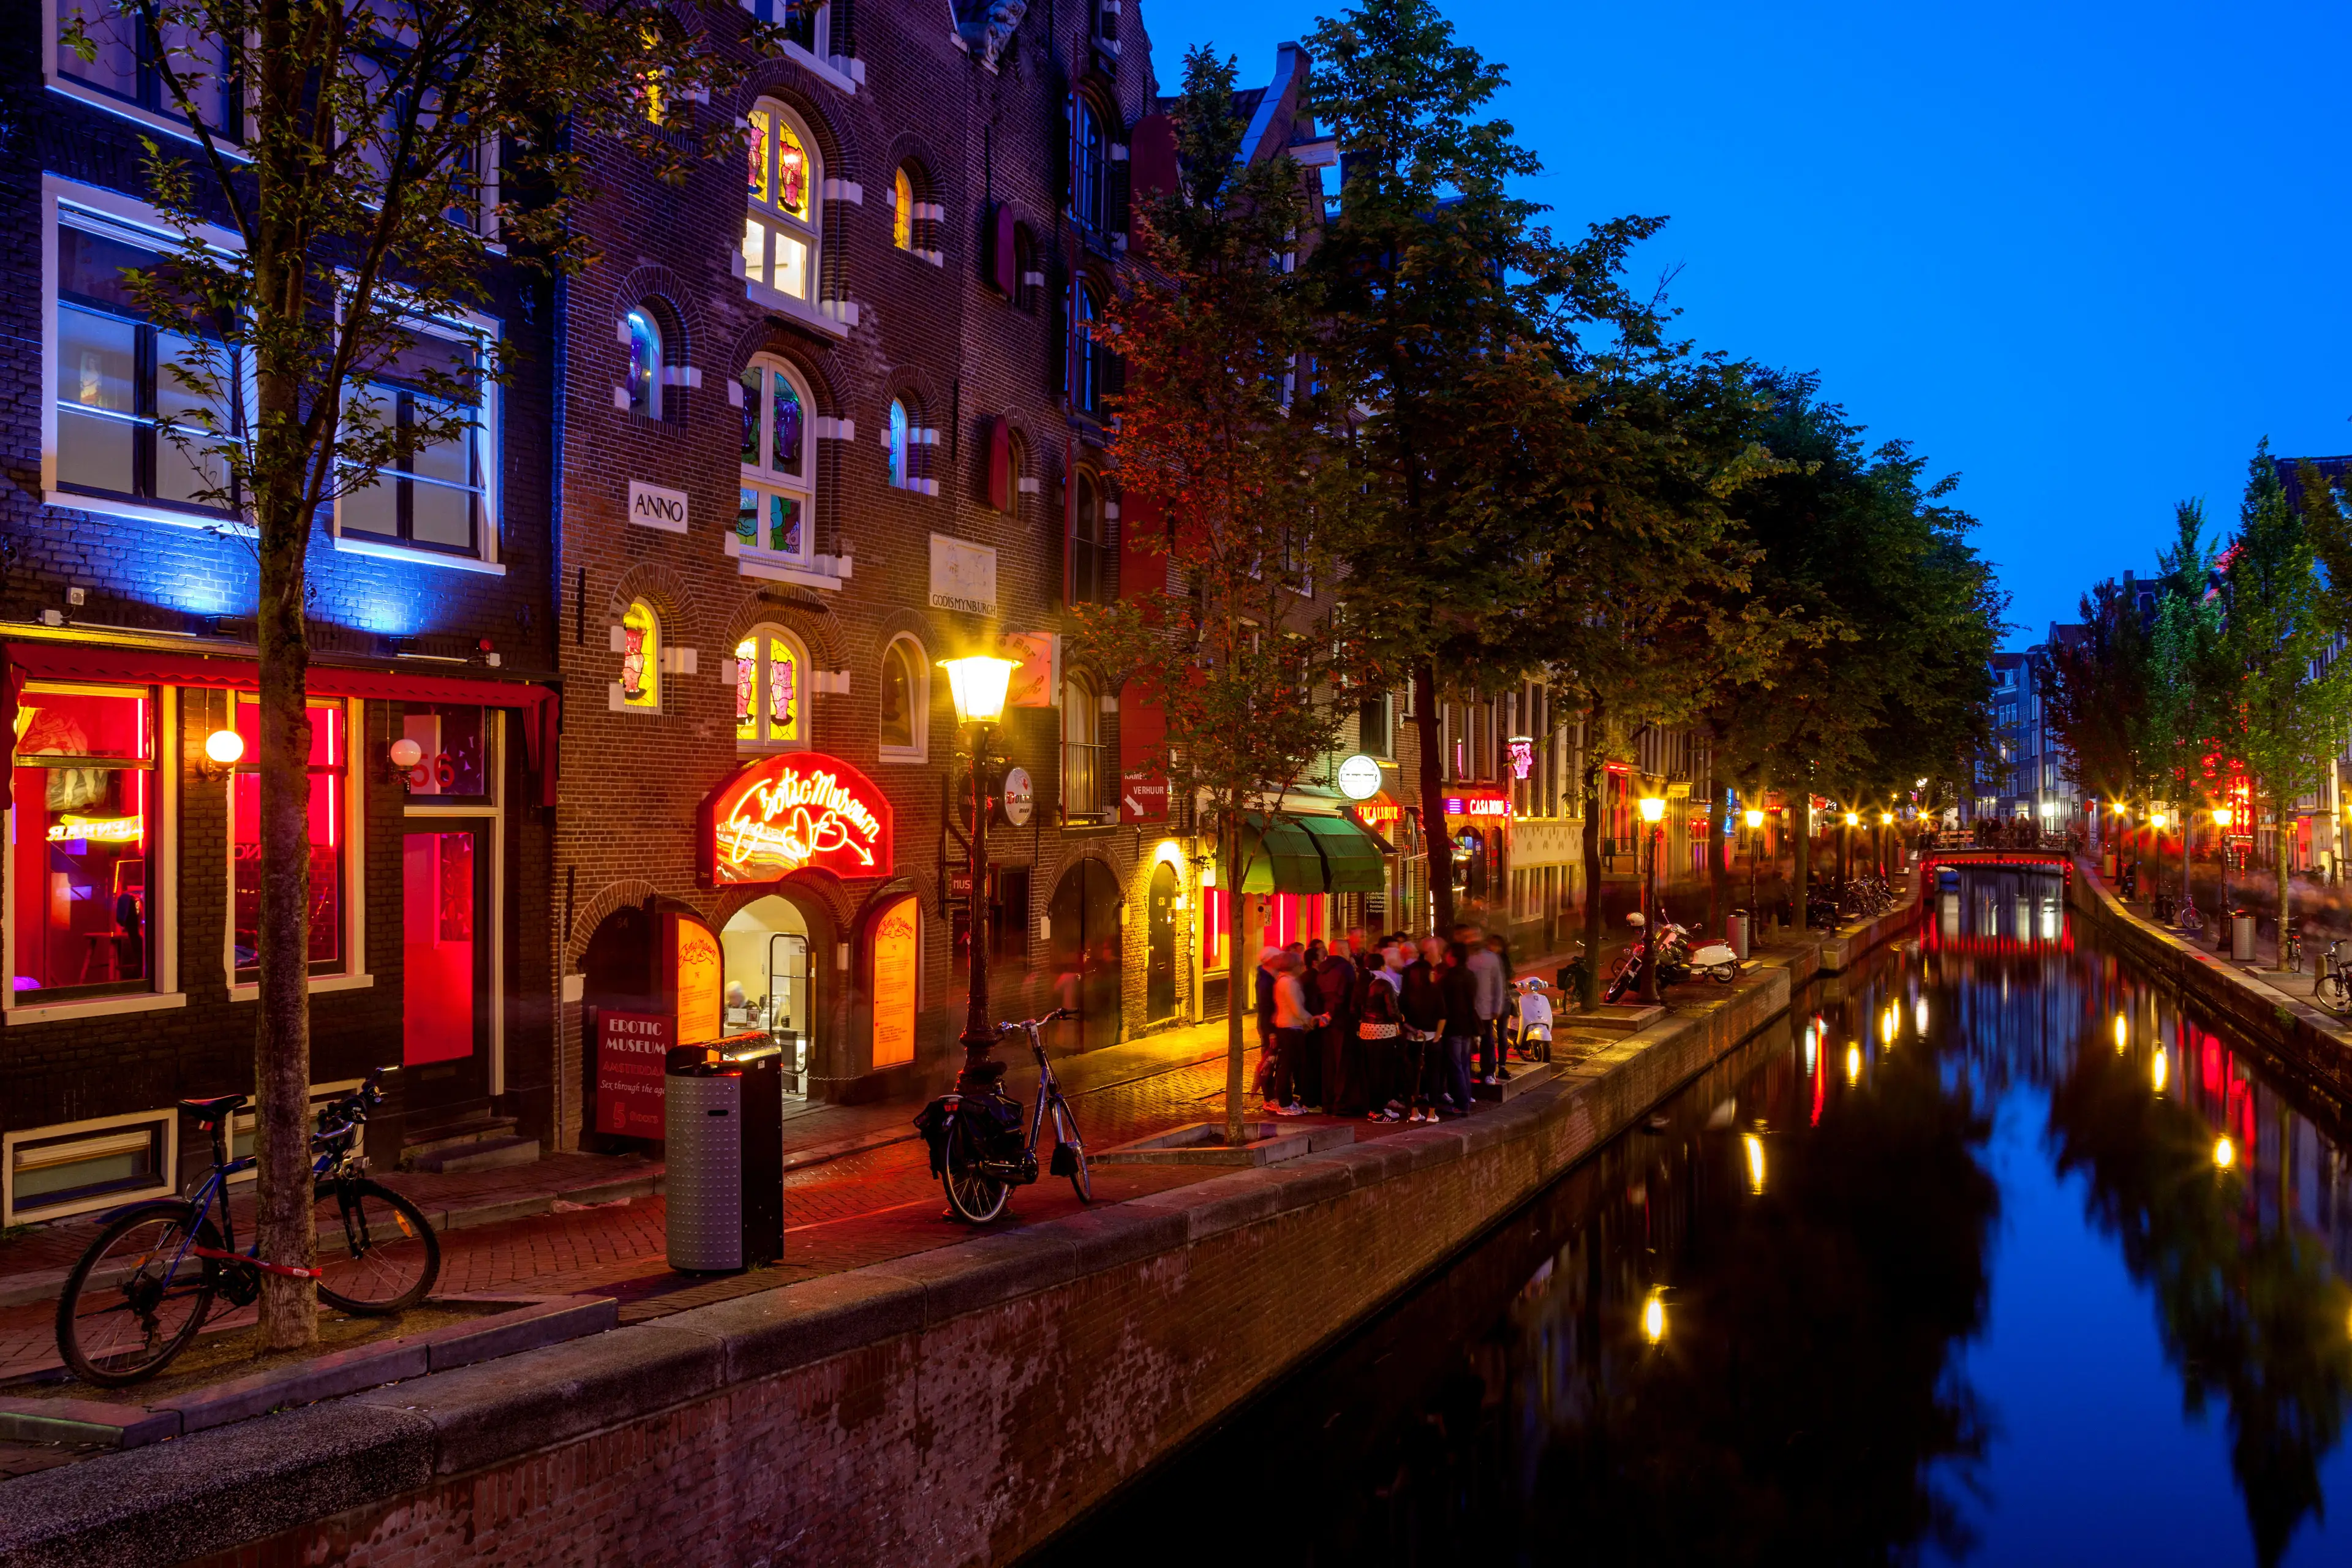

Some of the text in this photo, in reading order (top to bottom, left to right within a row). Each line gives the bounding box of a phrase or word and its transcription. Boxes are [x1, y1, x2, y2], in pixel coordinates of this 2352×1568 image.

[635, 493, 684, 522] ANNO
[1013, 637, 1036, 658] Bar
[410, 753, 454, 788] 56
[1133, 786, 1164, 794] VERHUUR
[729, 767, 880, 864] Erotic Museum
[1358, 806, 1398, 820] EXCALIBUR
[1470, 799, 1489, 815] CASA
[609, 1019, 662, 1036] EROTIC
[605, 1038, 666, 1055] MUSEUM
[600, 1080, 614, 1090] Sex
[614, 1081, 640, 1094] through
[642, 1084, 652, 1093] the
[613, 1102, 626, 1128] 5
